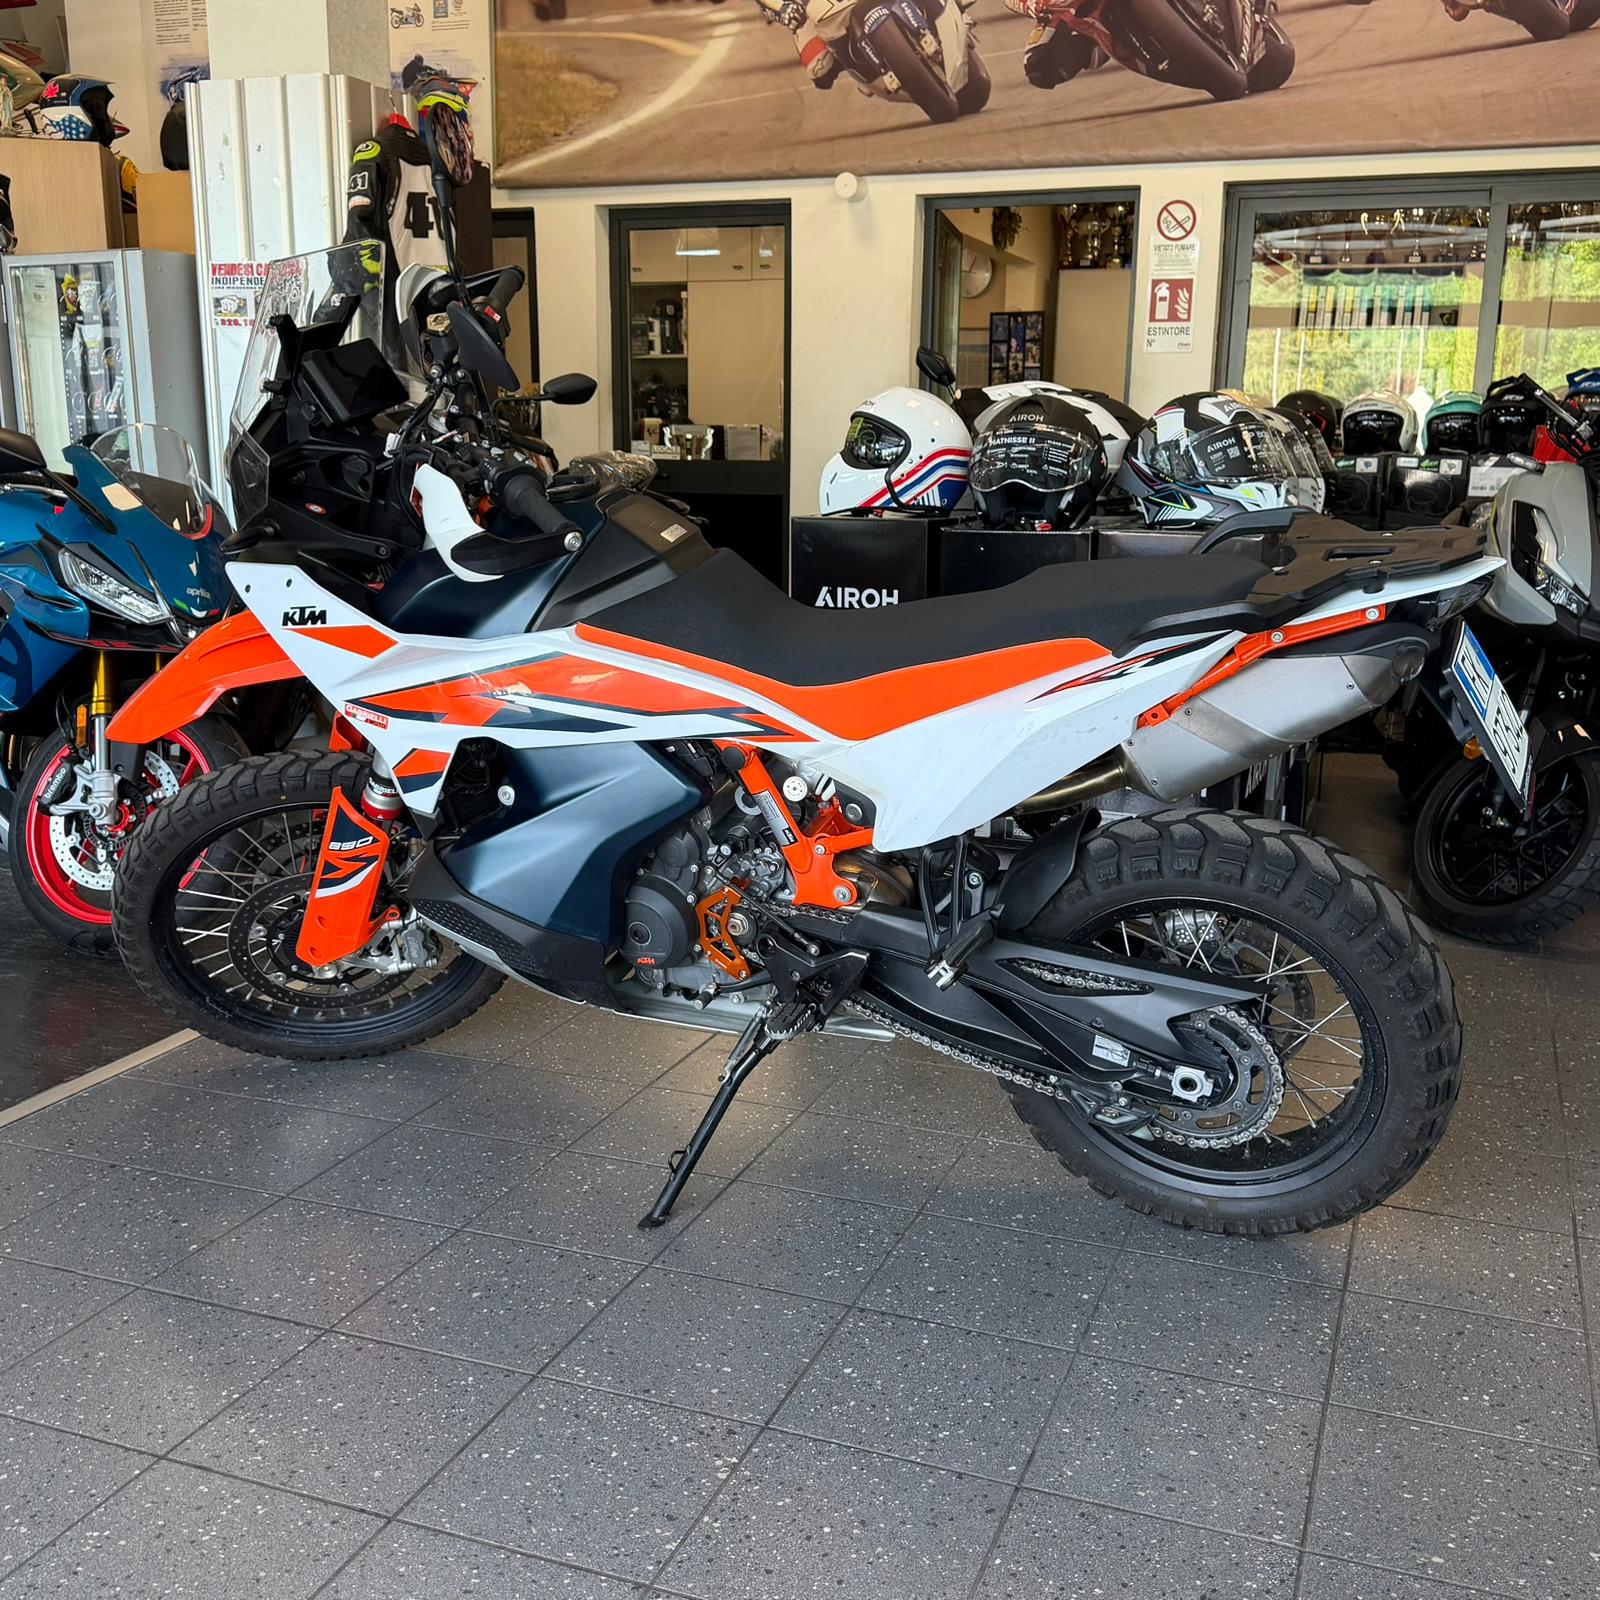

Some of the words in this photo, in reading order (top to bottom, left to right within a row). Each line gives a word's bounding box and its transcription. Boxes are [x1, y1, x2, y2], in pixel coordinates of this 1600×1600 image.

[211, 263, 254, 277] VENDESI
[1147, 327, 1190, 336] ESTINTORE
[1009, 414, 1044, 422] AIROH
[1207, 437, 1236, 453] AIROH
[186, 587, 211, 600] aprilia
[814, 585, 899, 609] AIROH
[282, 606, 327, 627] KTM
[43, 767, 67, 799] brembo
[328, 836, 374, 851] 890
[637, 957, 656, 965] KTM
